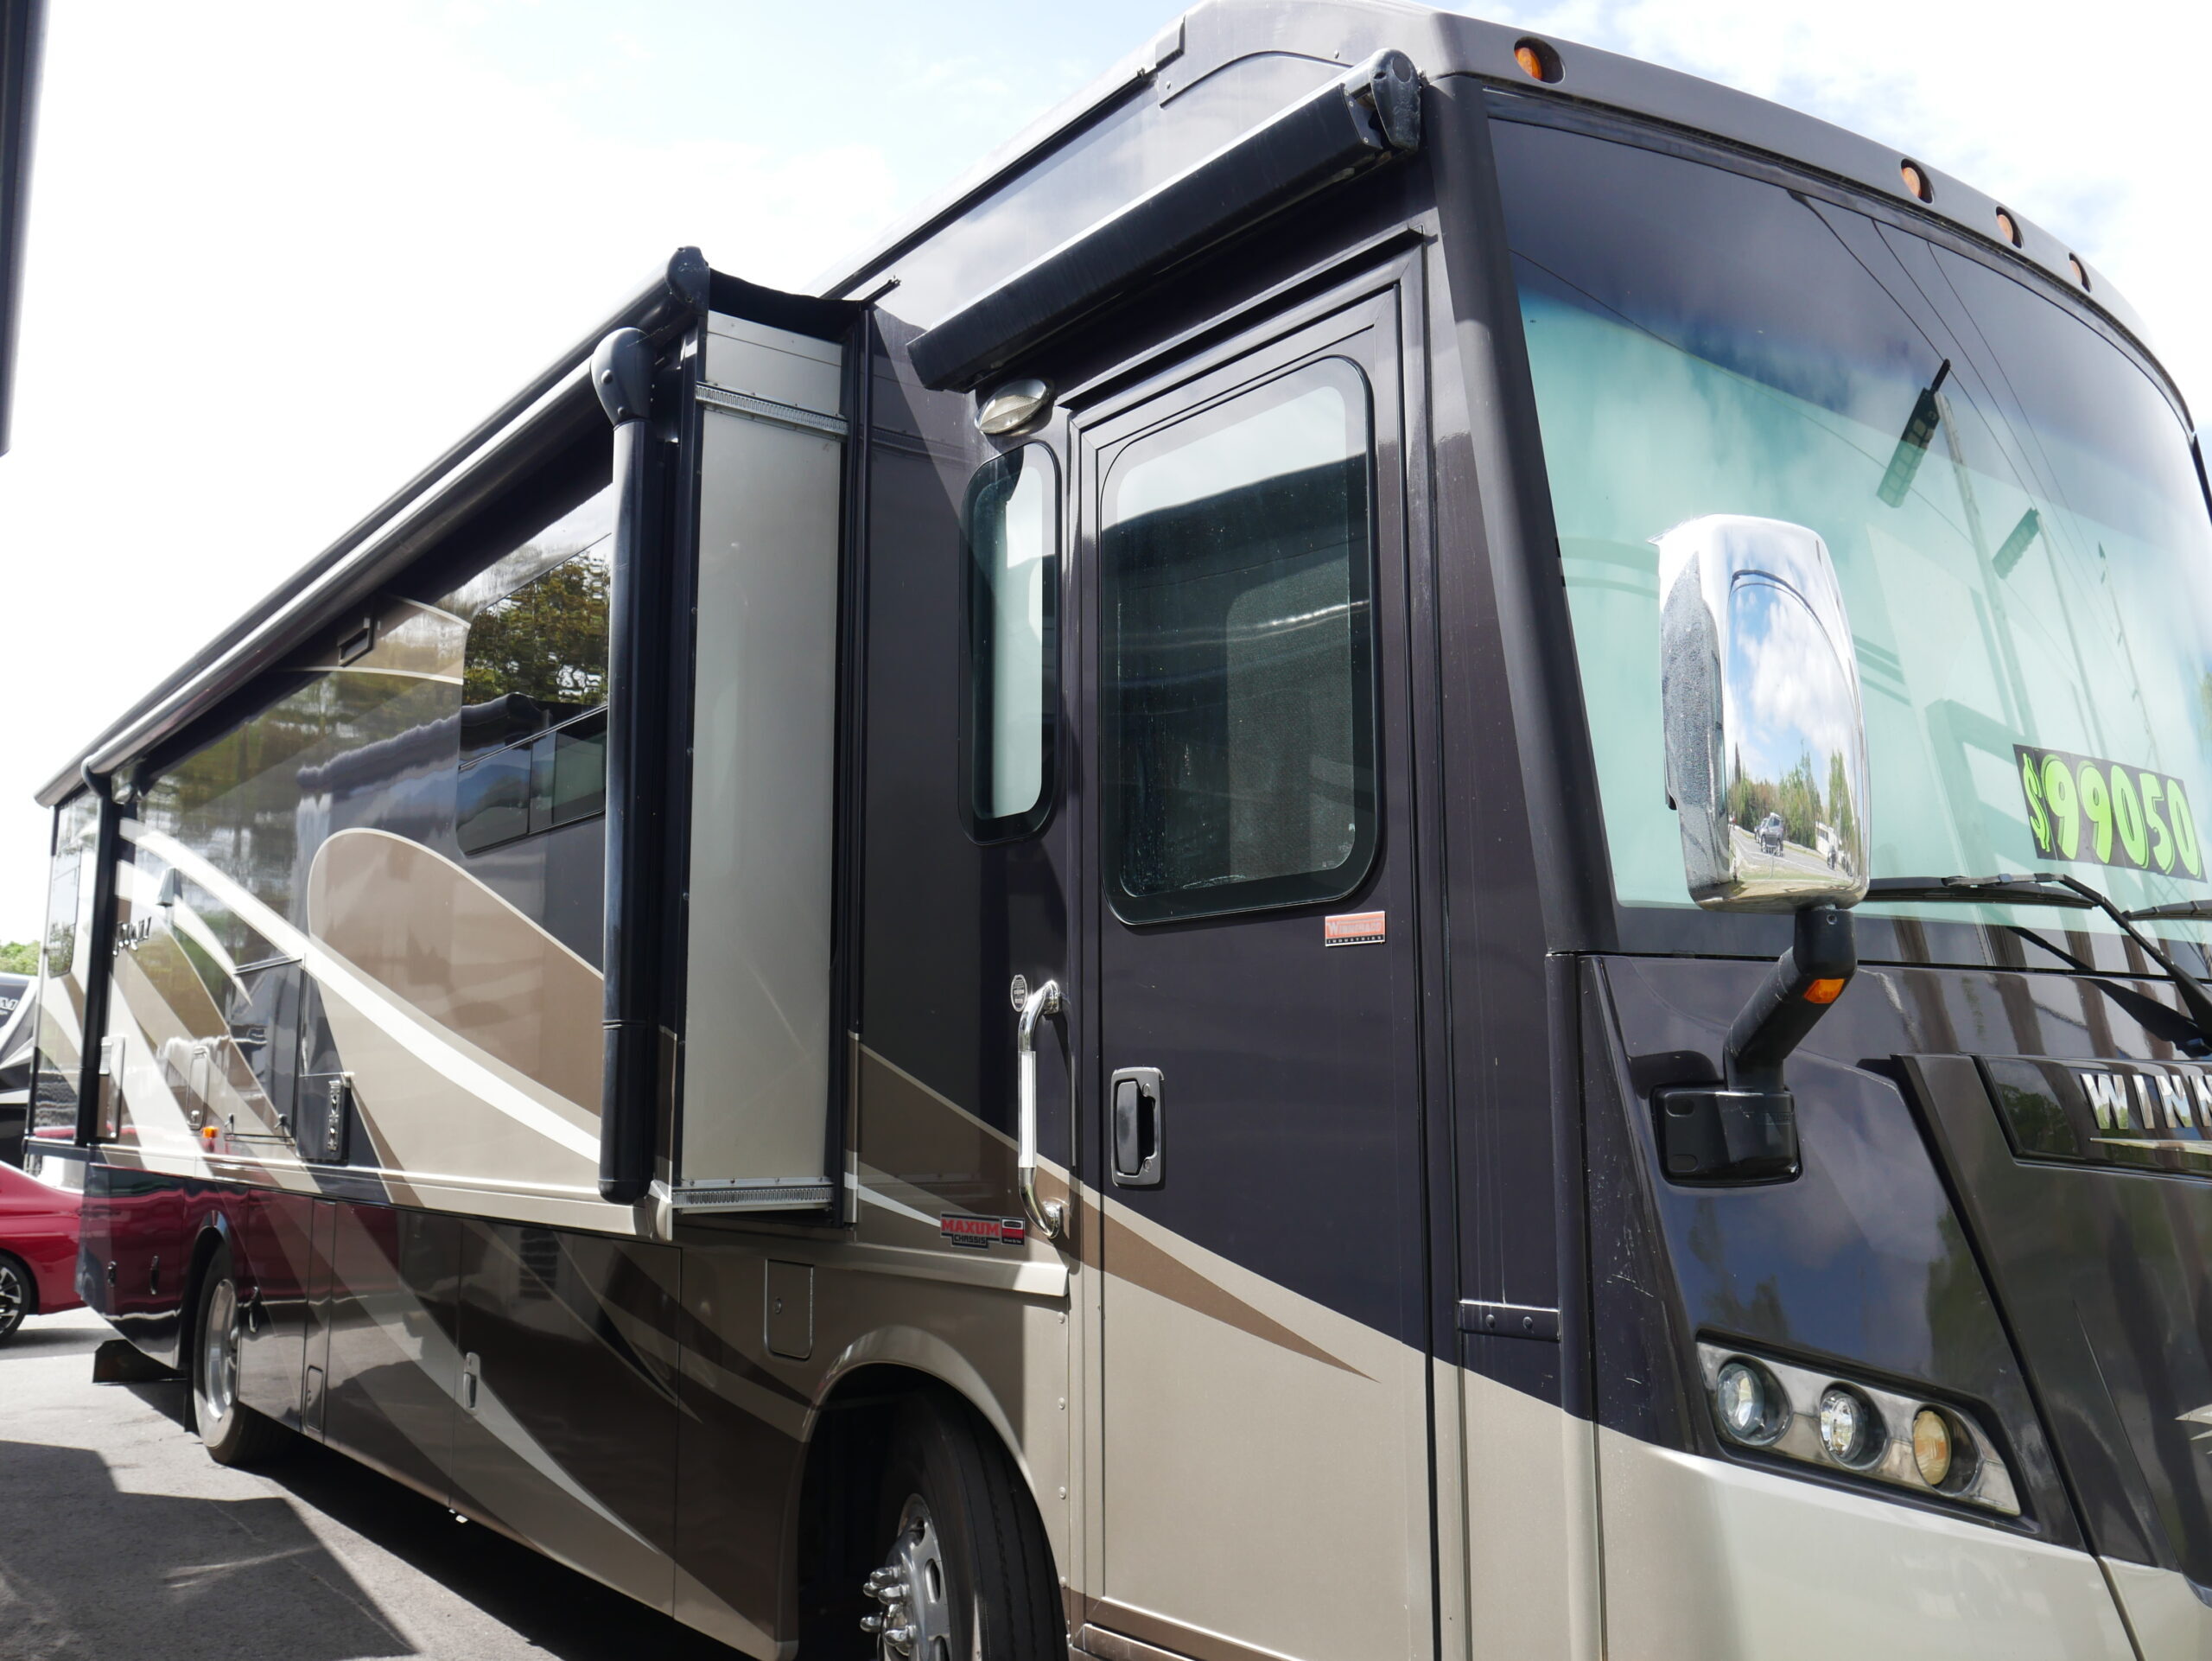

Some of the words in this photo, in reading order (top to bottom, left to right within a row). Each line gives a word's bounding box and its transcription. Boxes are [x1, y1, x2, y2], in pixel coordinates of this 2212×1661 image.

[2023, 754, 2202, 880] $99050
[941, 1219, 1001, 1237] MAXUM
[954, 1234, 987, 1244] CHASSIS
